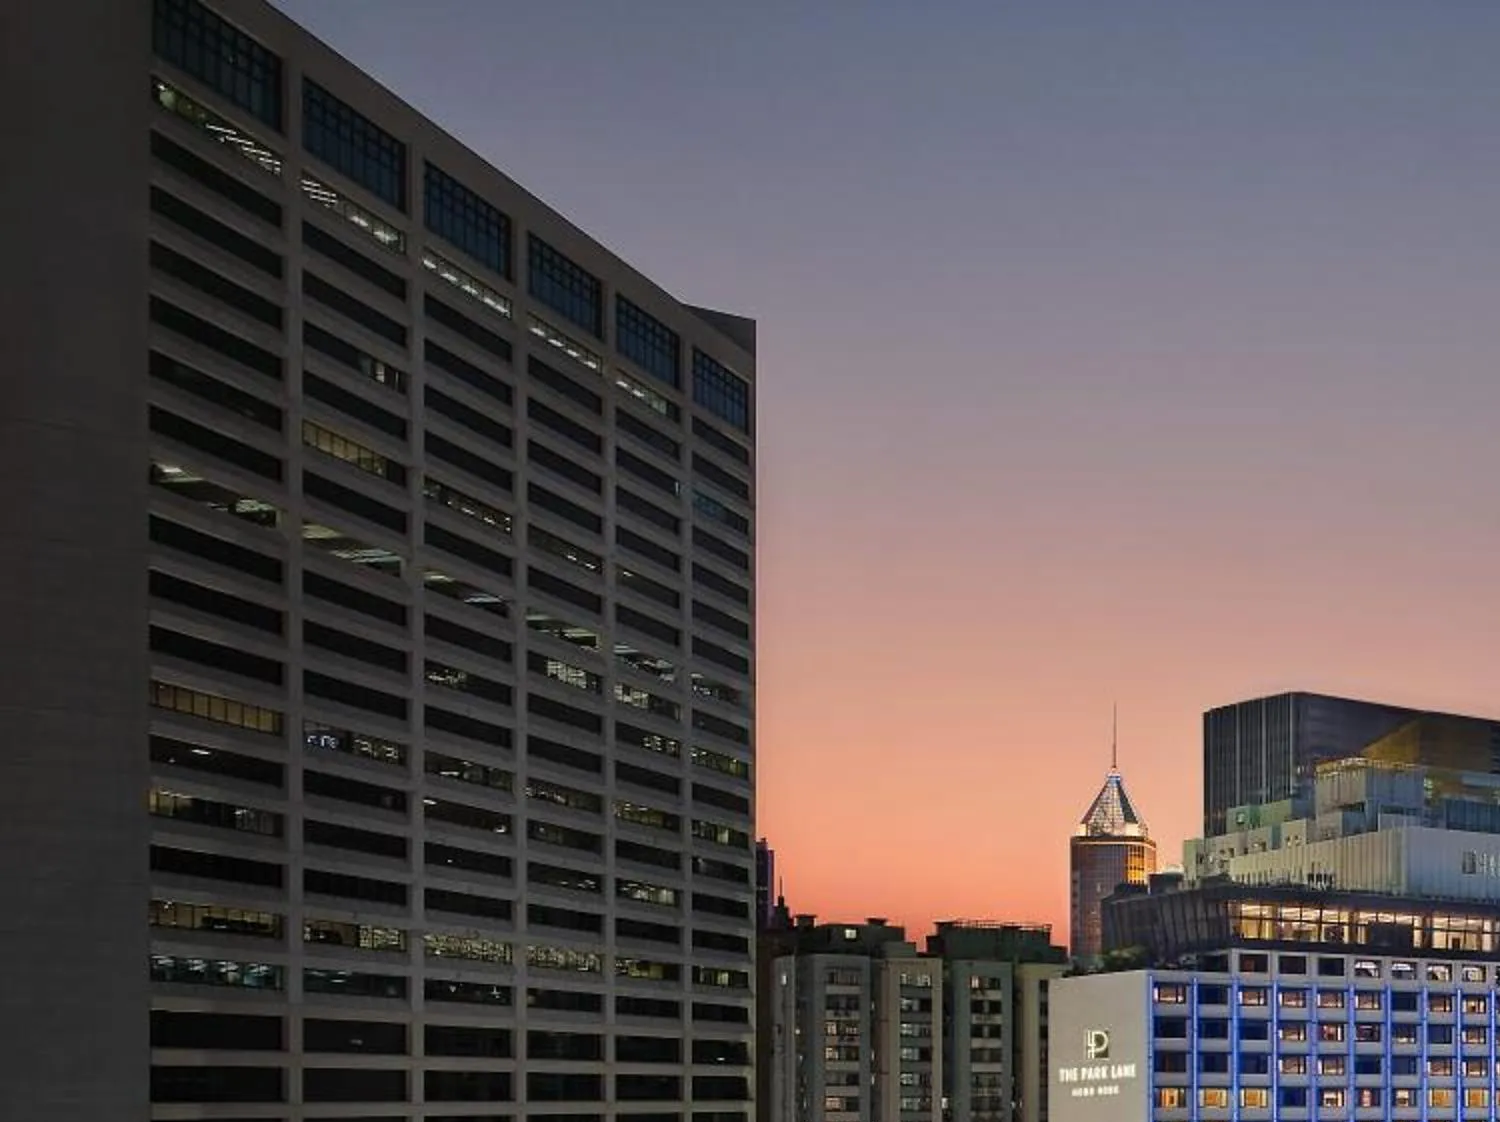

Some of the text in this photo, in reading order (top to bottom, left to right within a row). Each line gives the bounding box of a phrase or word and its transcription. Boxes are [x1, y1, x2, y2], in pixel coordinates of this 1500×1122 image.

[1059, 1063, 1136, 1082] THE PARK LANE
